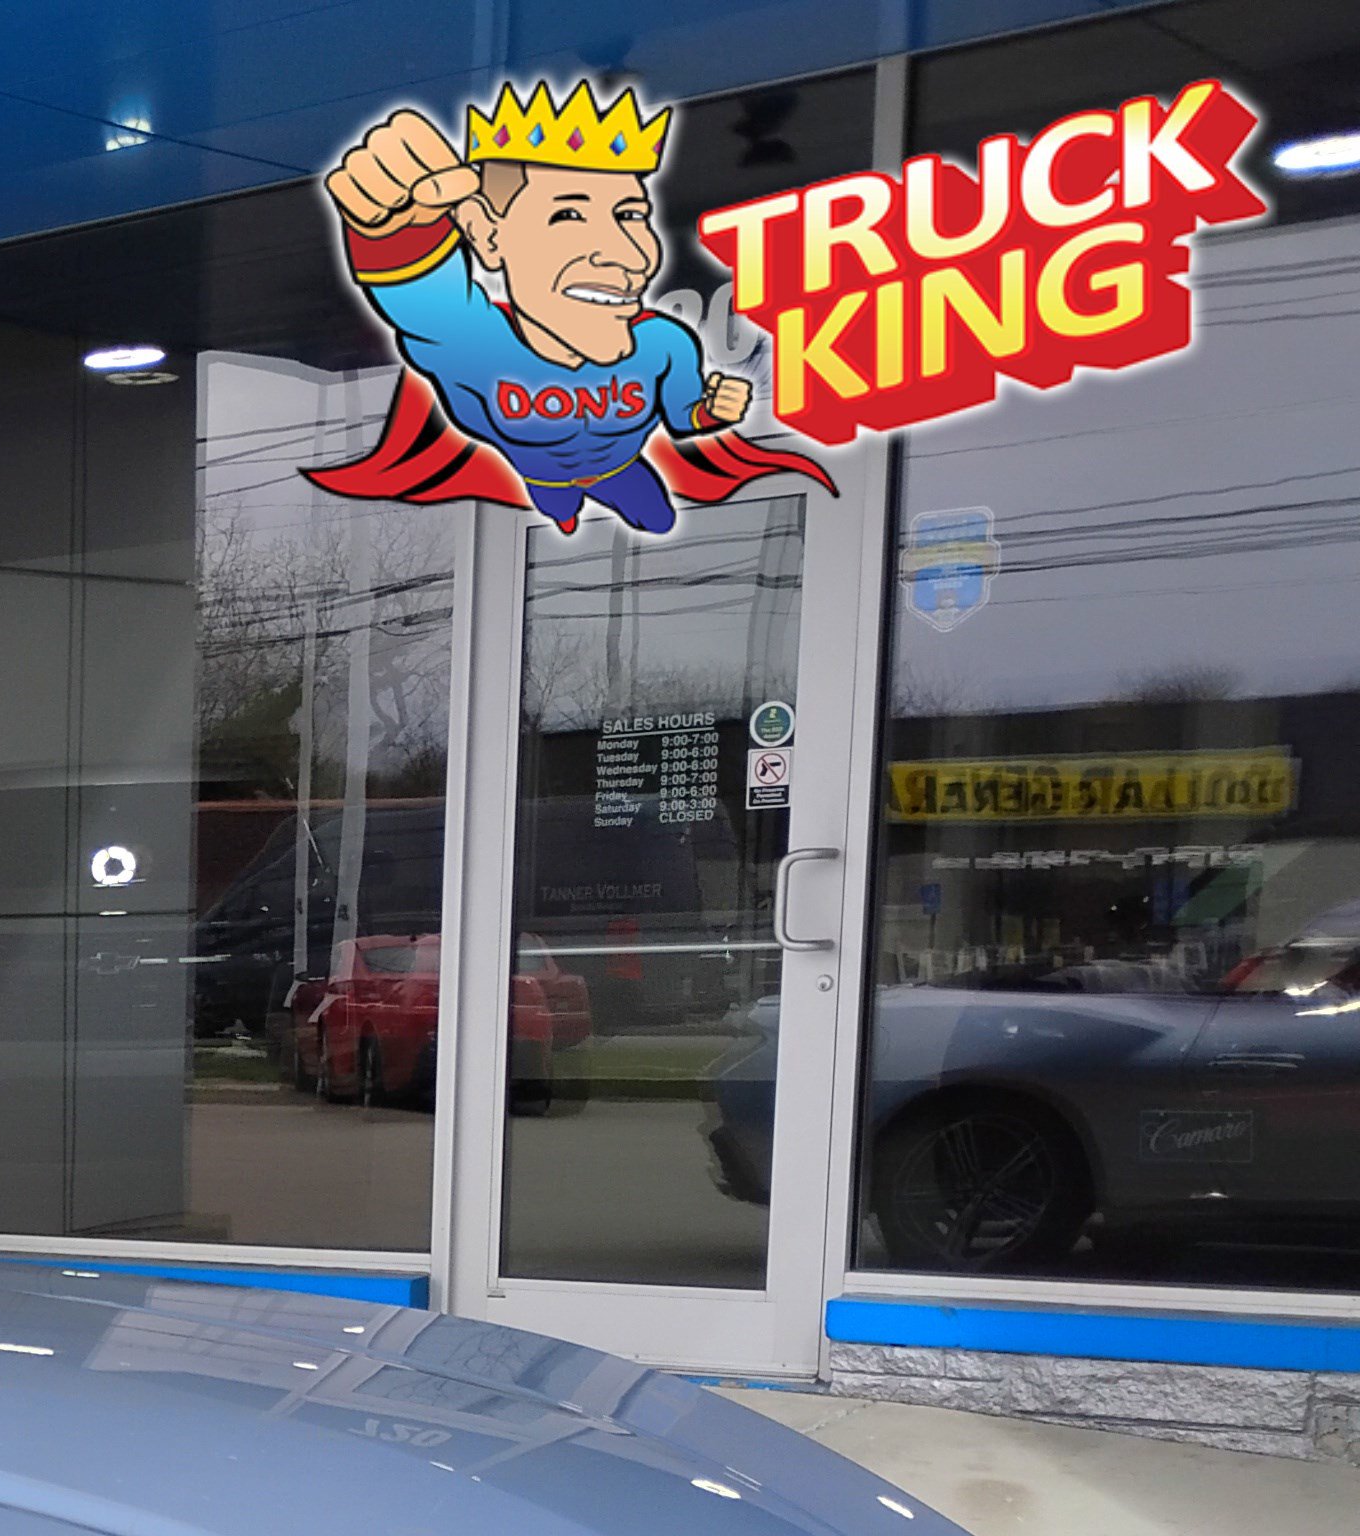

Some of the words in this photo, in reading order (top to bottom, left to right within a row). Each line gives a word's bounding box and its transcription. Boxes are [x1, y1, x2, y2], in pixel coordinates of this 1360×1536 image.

[602, 717, 654, 734] SALES
[658, 712, 716, 729] HOURS
[597, 738, 639, 750] Monday
[662, 733, 719, 747] 9:00-7:00
[597, 752, 639, 763] Tuesday
[661, 746, 718, 759] 9:00-6:00
[596, 763, 658, 776] Wednesday
[596, 777, 644, 789] Thursday
[660, 772, 717, 785] 9:00-7:00
[595, 791, 628, 803] Friday
[660, 785, 717, 798] 9:00-6:00
[595, 802, 642, 815] Saturday
[594, 816, 633, 828] Sunday
[659, 809, 714, 824] CLOSED
[596, 883, 662, 899] VOLLMER
[1144, 1119, 1253, 1154] Camaro
